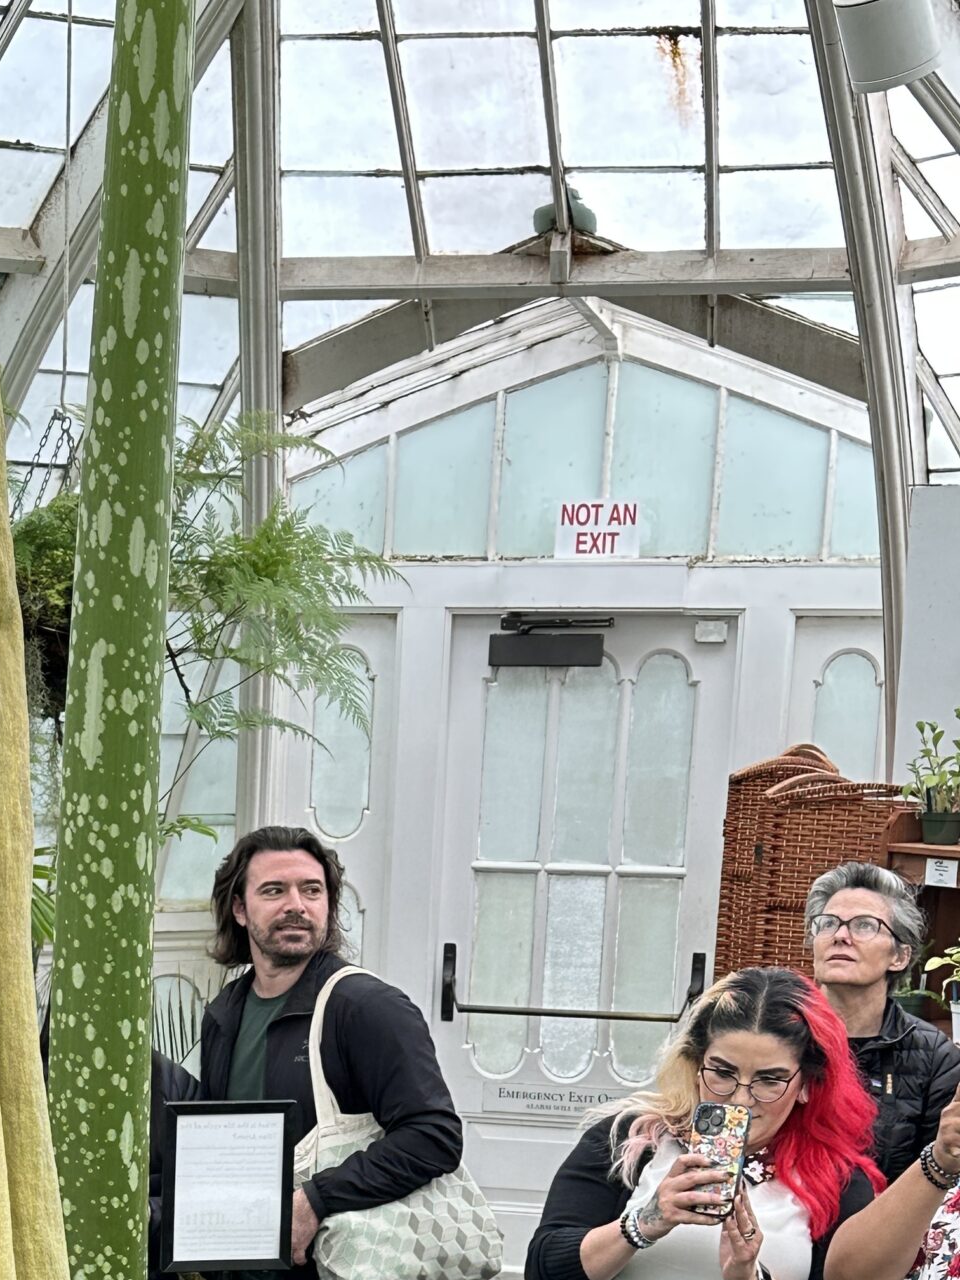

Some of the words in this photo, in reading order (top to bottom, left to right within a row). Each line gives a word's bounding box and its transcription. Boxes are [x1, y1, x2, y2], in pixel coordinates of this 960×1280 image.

[561, 503, 604, 526] NOT
[607, 503, 637, 526] AN
[575, 532, 620, 554] EXIT
[498, 1087, 565, 1102] EMERGENCY
[569, 1091, 595, 1103] EXIT
